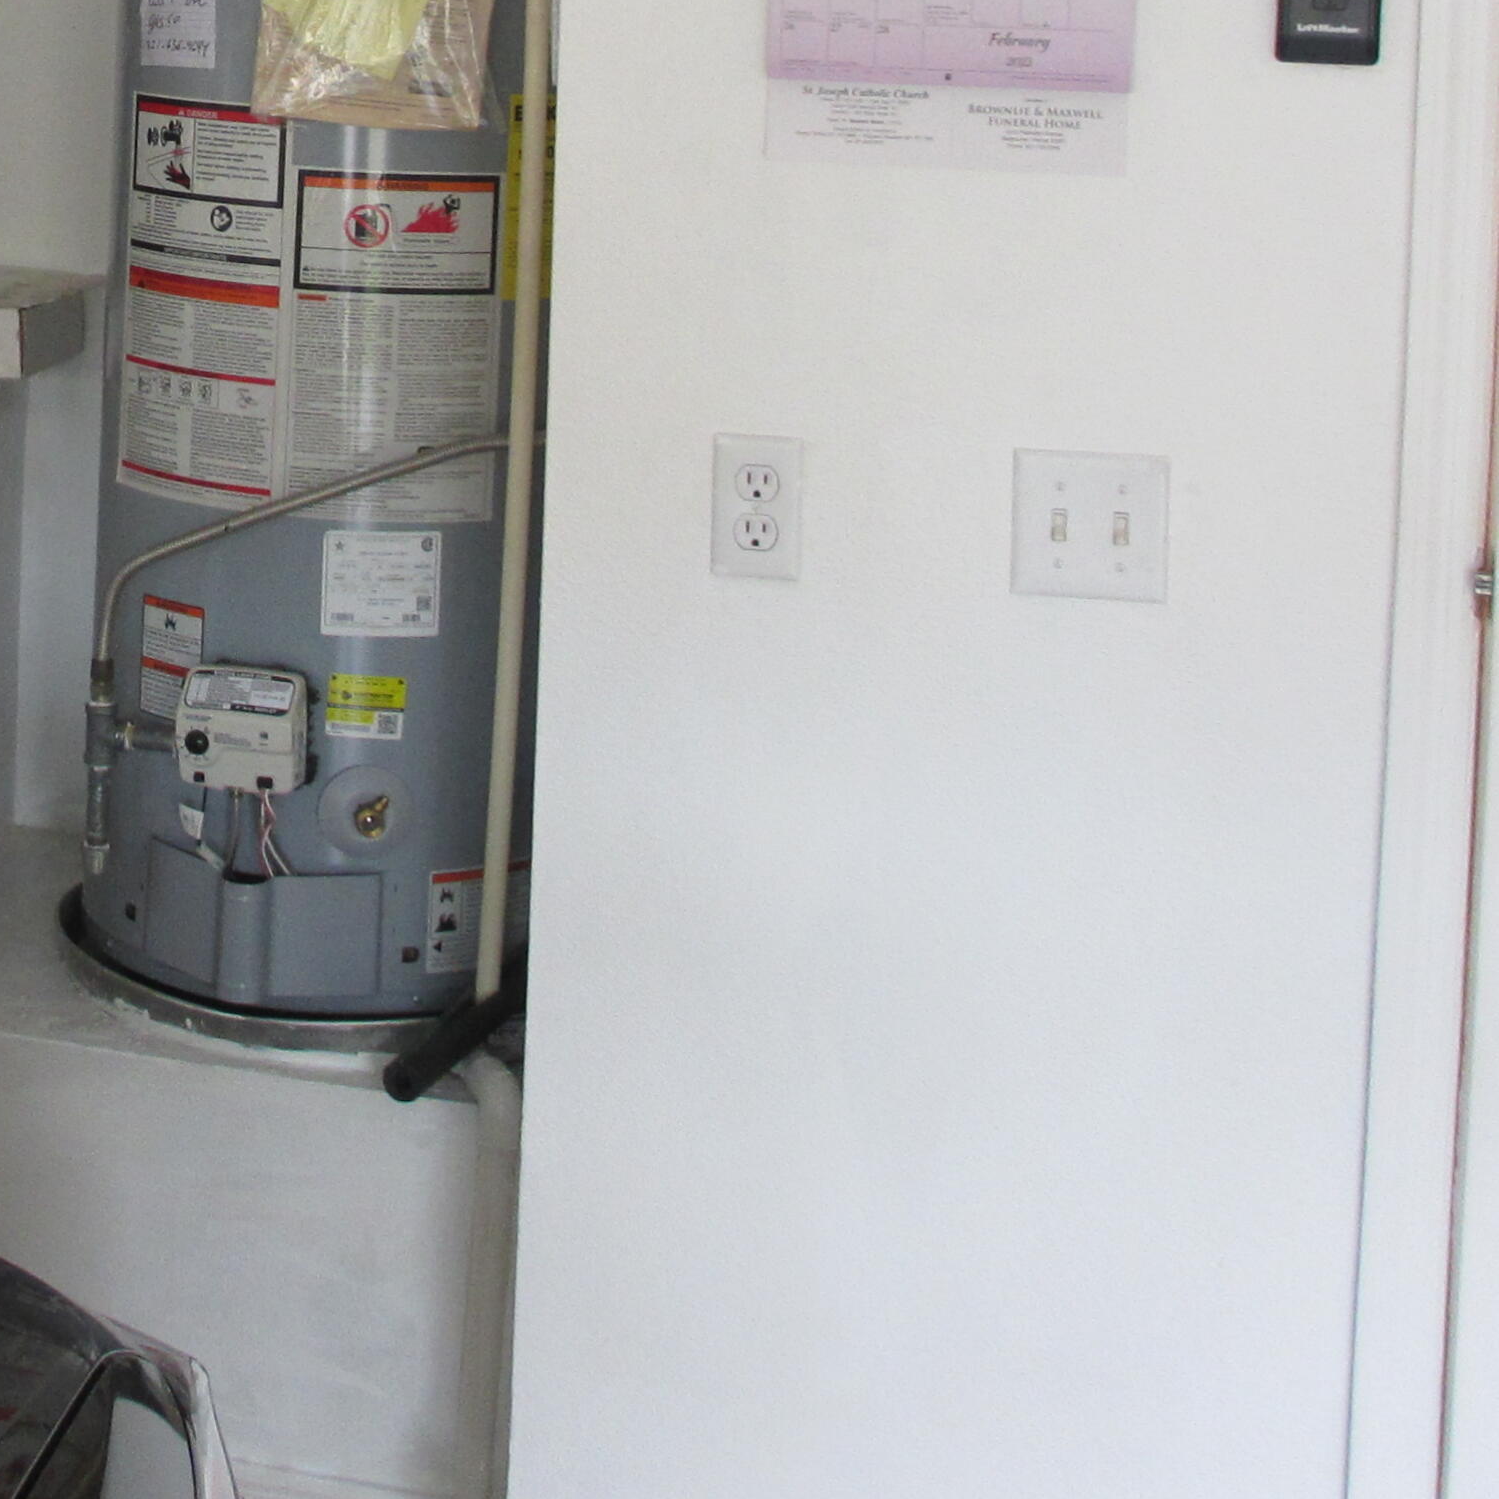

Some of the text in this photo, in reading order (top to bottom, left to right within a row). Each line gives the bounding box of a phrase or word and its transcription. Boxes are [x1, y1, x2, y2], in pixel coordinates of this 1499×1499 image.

[988, 32, 1051, 52] February
[817, 86, 849, 100] Joseph
[851, 87, 891, 99] Catholic
[893, 88, 930, 100] Church
